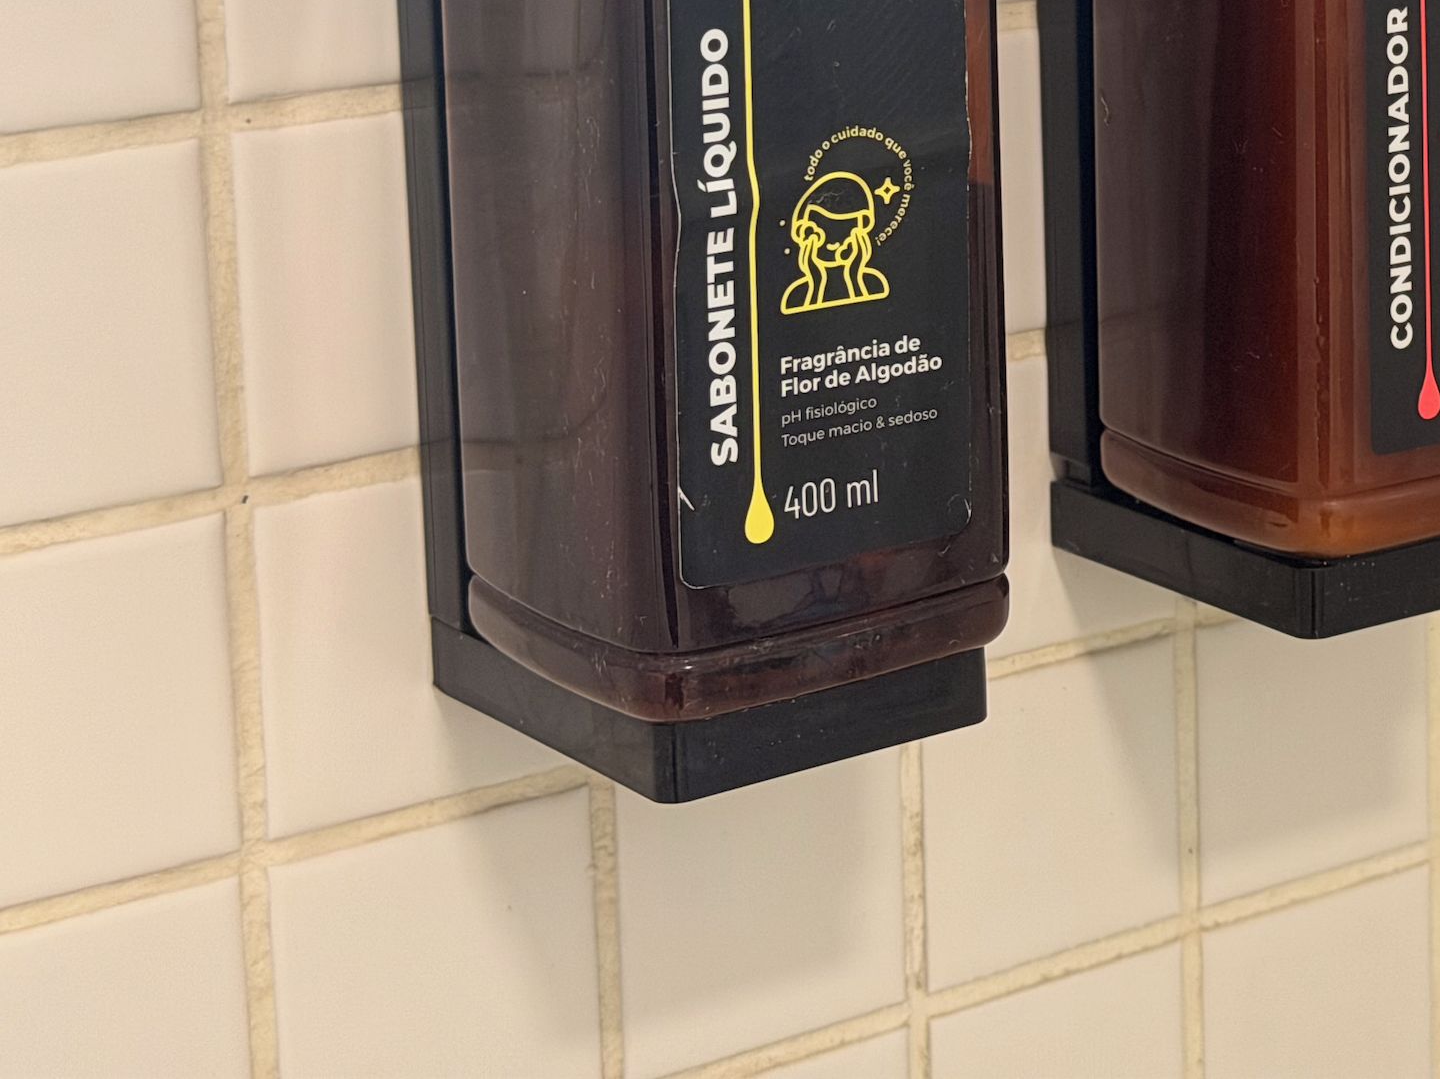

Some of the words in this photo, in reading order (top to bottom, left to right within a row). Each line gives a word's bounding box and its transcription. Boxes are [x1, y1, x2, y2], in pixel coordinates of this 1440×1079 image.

[697, 28, 738, 219] LÍQUIDO
[831, 125, 884, 143] cuidado
[804, 149, 823, 181] todo
[822, 140, 831, 150] o
[884, 137, 907, 159] que
[903, 159, 915, 191] você
[1386, 6, 1414, 350] CONDICIONADOR
[875, 194, 911, 246] merece!
[706, 227, 739, 467] SABONETE
[780, 339, 891, 376] Fragrância
[894, 334, 921, 354] de
[781, 376, 822, 398] Flor
[824, 369, 851, 389] de
[855, 354, 943, 384] Algodão
[781, 409, 801, 428] pH
[805, 397, 878, 421] fisiológico
[781, 429, 825, 448] Toque
[828, 420, 873, 439] macio
[875, 415, 885, 430] &
[888, 408, 938, 427] sedoso
[784, 477, 837, 520] 400
[846, 469, 879, 508] ml
